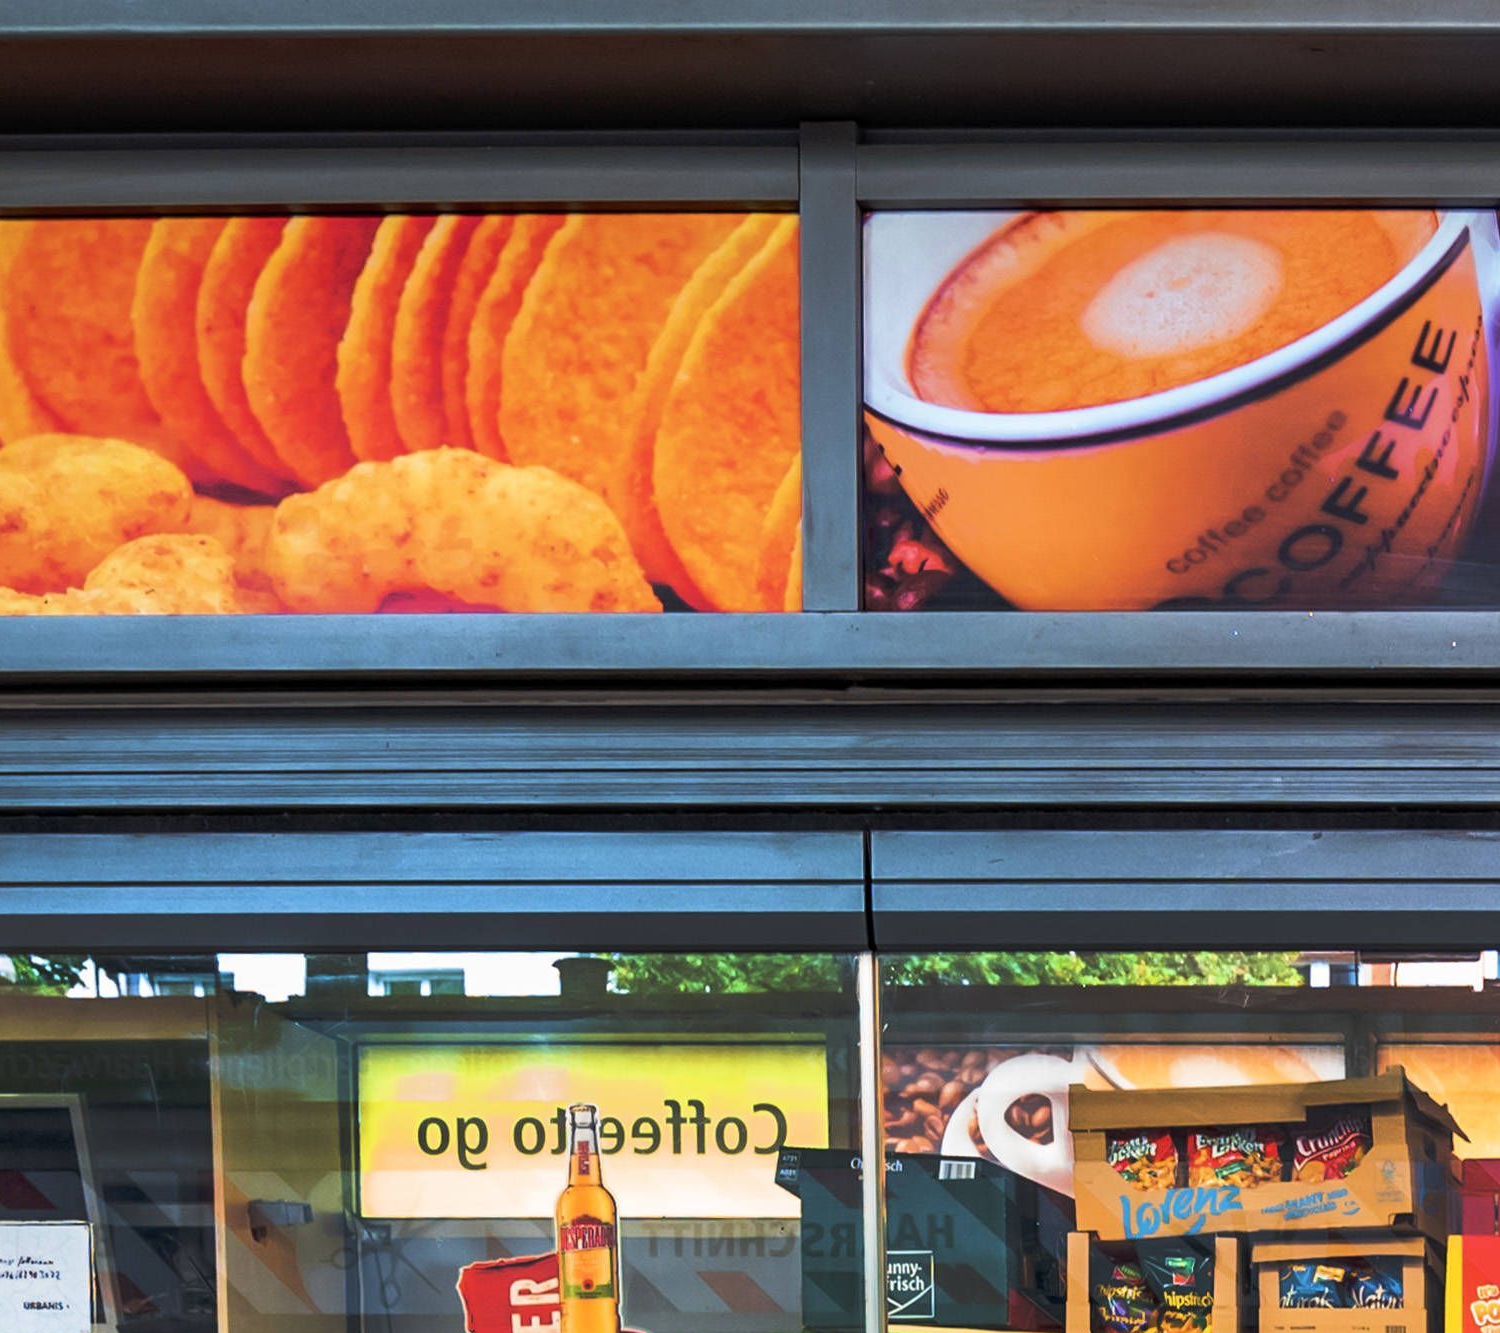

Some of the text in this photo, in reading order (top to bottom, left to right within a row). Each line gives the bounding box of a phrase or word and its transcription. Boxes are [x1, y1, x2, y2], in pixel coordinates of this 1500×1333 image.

[1166, 409, 1348, 575] coffee coffee
[1223, 320, 1457, 602] COFFEE
[1121, 1186, 1243, 1241] Lorenz
[23, 1301, 64, 1311] URBANIS
